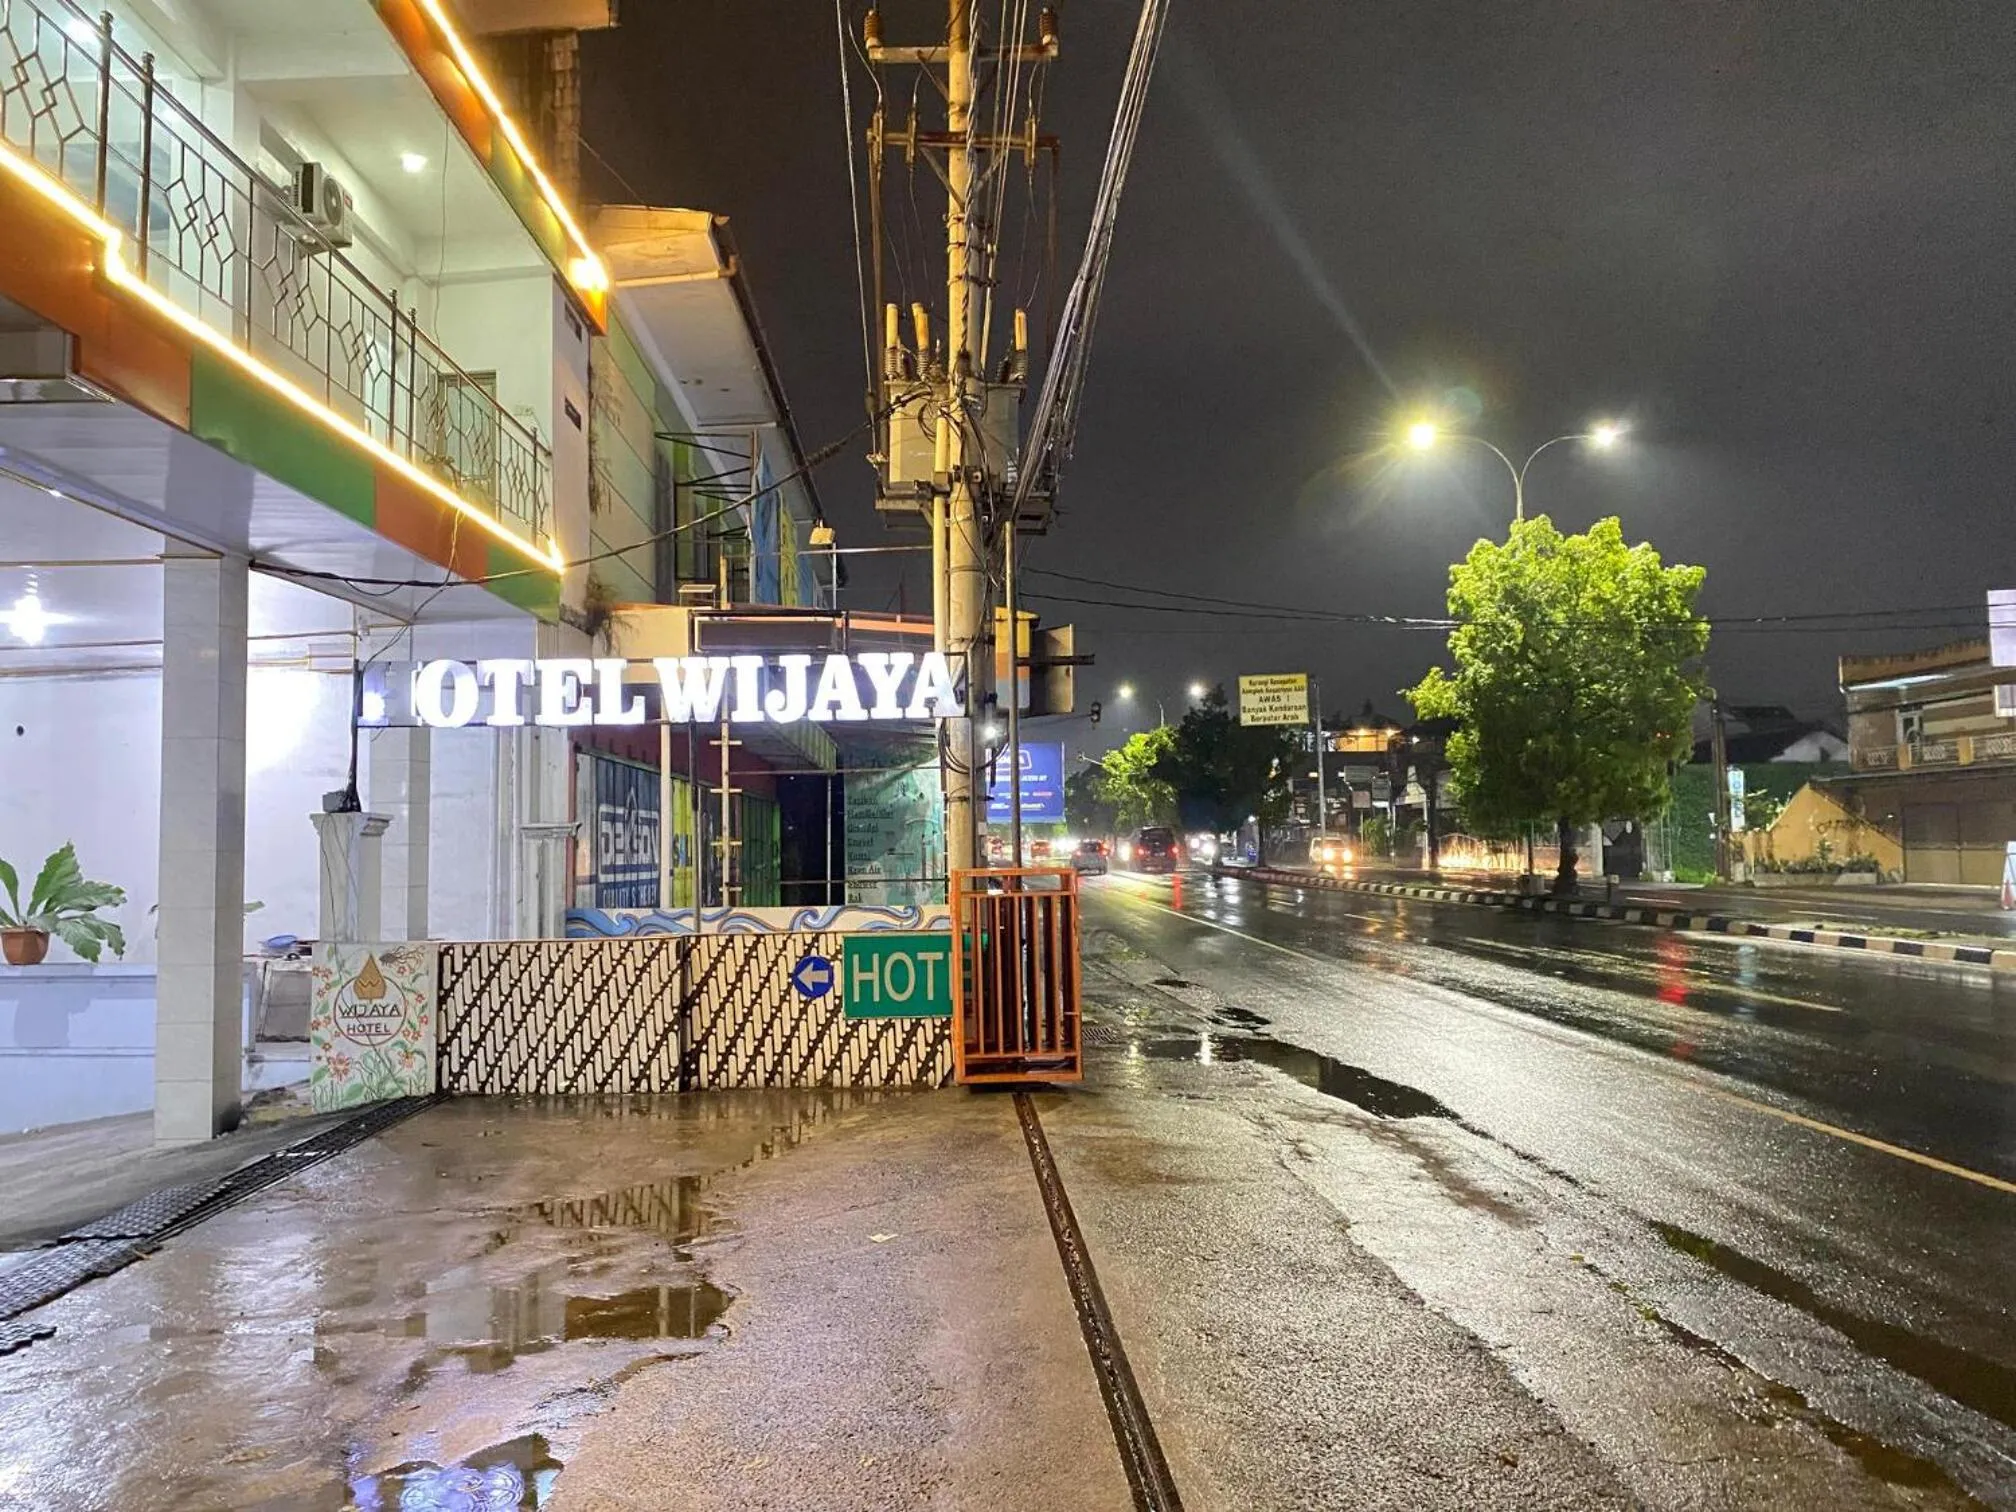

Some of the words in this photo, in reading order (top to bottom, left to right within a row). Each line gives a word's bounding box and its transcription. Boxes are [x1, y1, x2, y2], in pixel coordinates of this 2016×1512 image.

[651, 651, 962, 725] WIJAYA
[1259, 695, 1281, 703] AWAS
[1242, 705, 1267, 714] Banyak
[1269, 704, 1306, 712] Kendaraan
[1250, 714, 1281, 723] Berputar
[338, 1004, 401, 1017] WIJAYA
[346, 1023, 391, 1033] HOTEL
